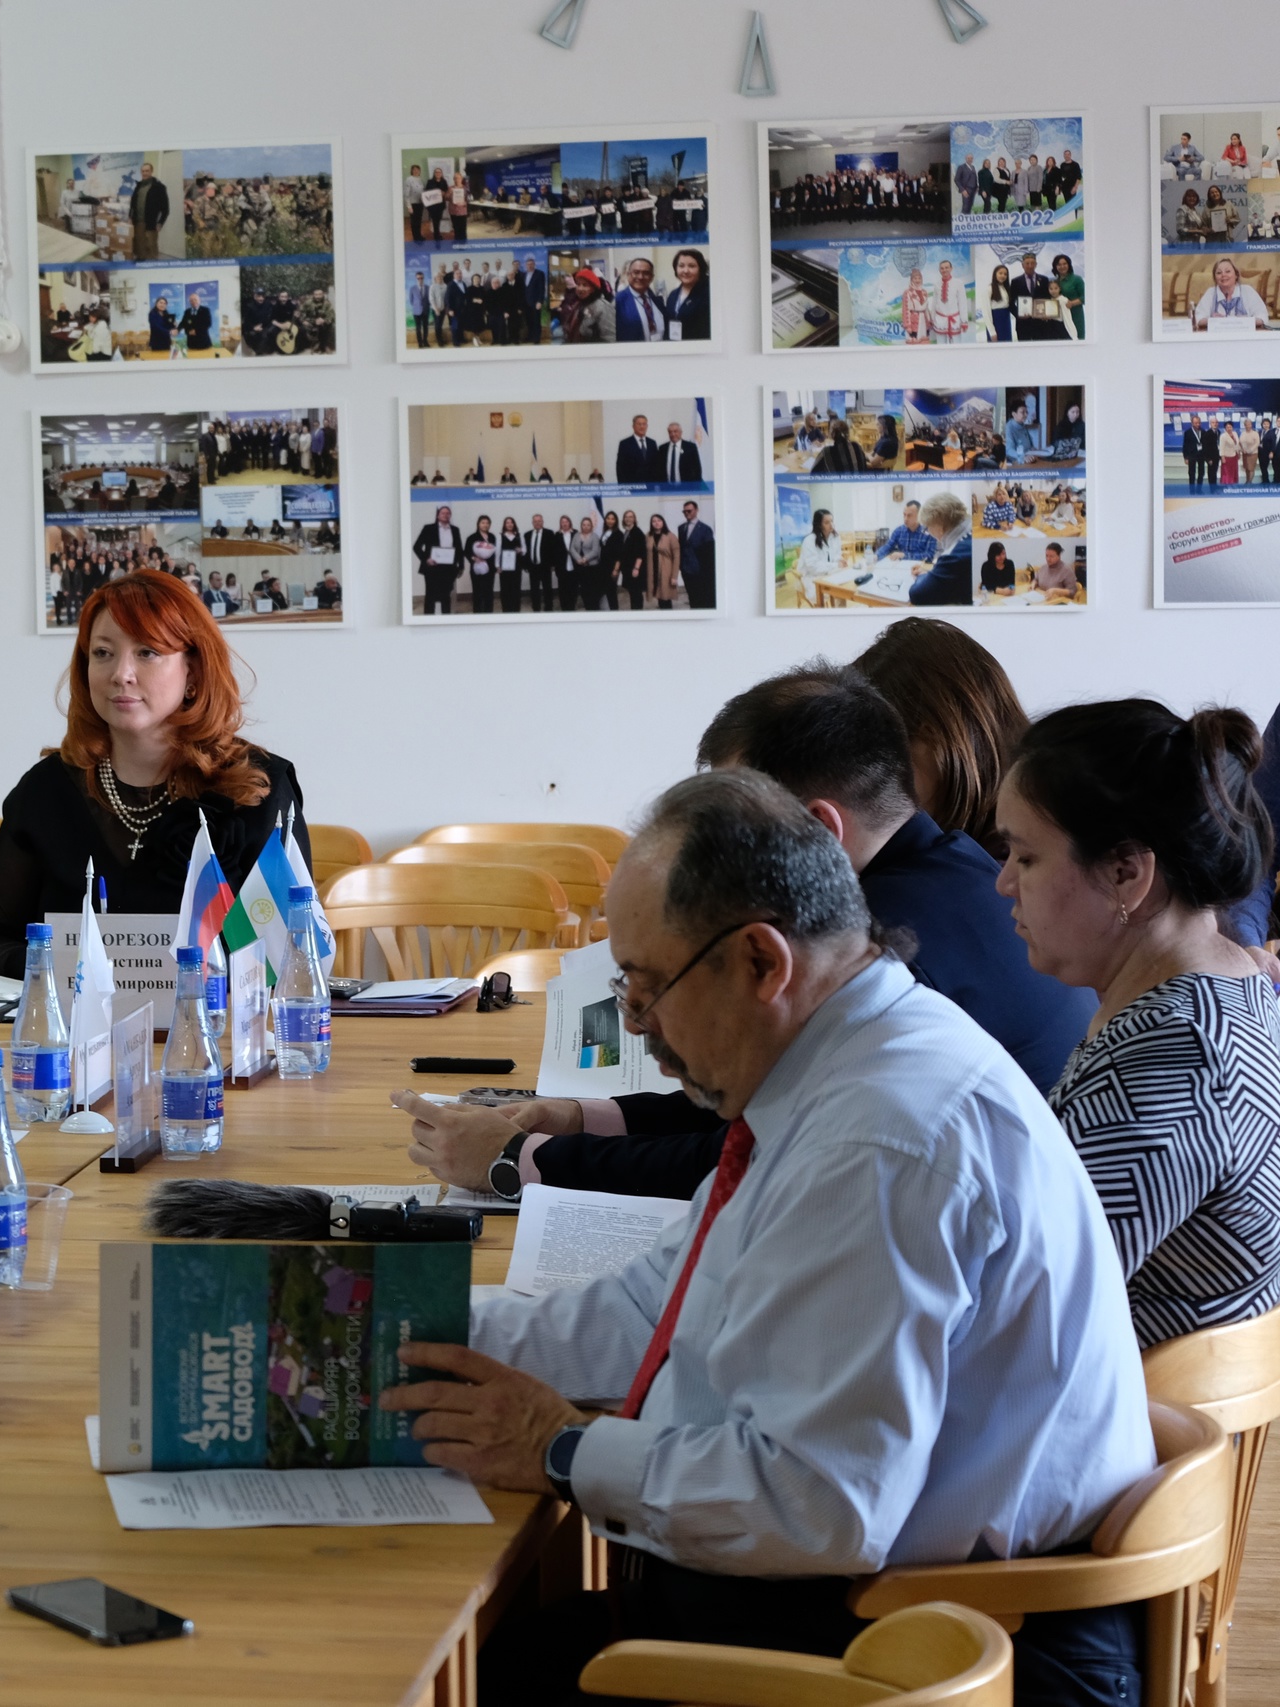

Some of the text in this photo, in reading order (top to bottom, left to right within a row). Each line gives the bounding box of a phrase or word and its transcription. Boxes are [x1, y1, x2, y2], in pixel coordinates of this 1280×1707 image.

[1010, 209, 1054, 228] 2022
[1167, 518, 1235, 541] «Сообщество»
[1169, 536, 1199, 551] форум
[1201, 524, 1242, 542] активных
[65, 933, 171, 947] НОРЕЗОВ
[113, 958, 163, 968] истина
[201, 1331, 231, 1441] SMART
[231, 1325, 256, 1442] САДОВОД
[343, 1318, 362, 1442] ВОЗМОЖНОСТИ
[322, 1357, 340, 1442] РАСШИРЯЯ
